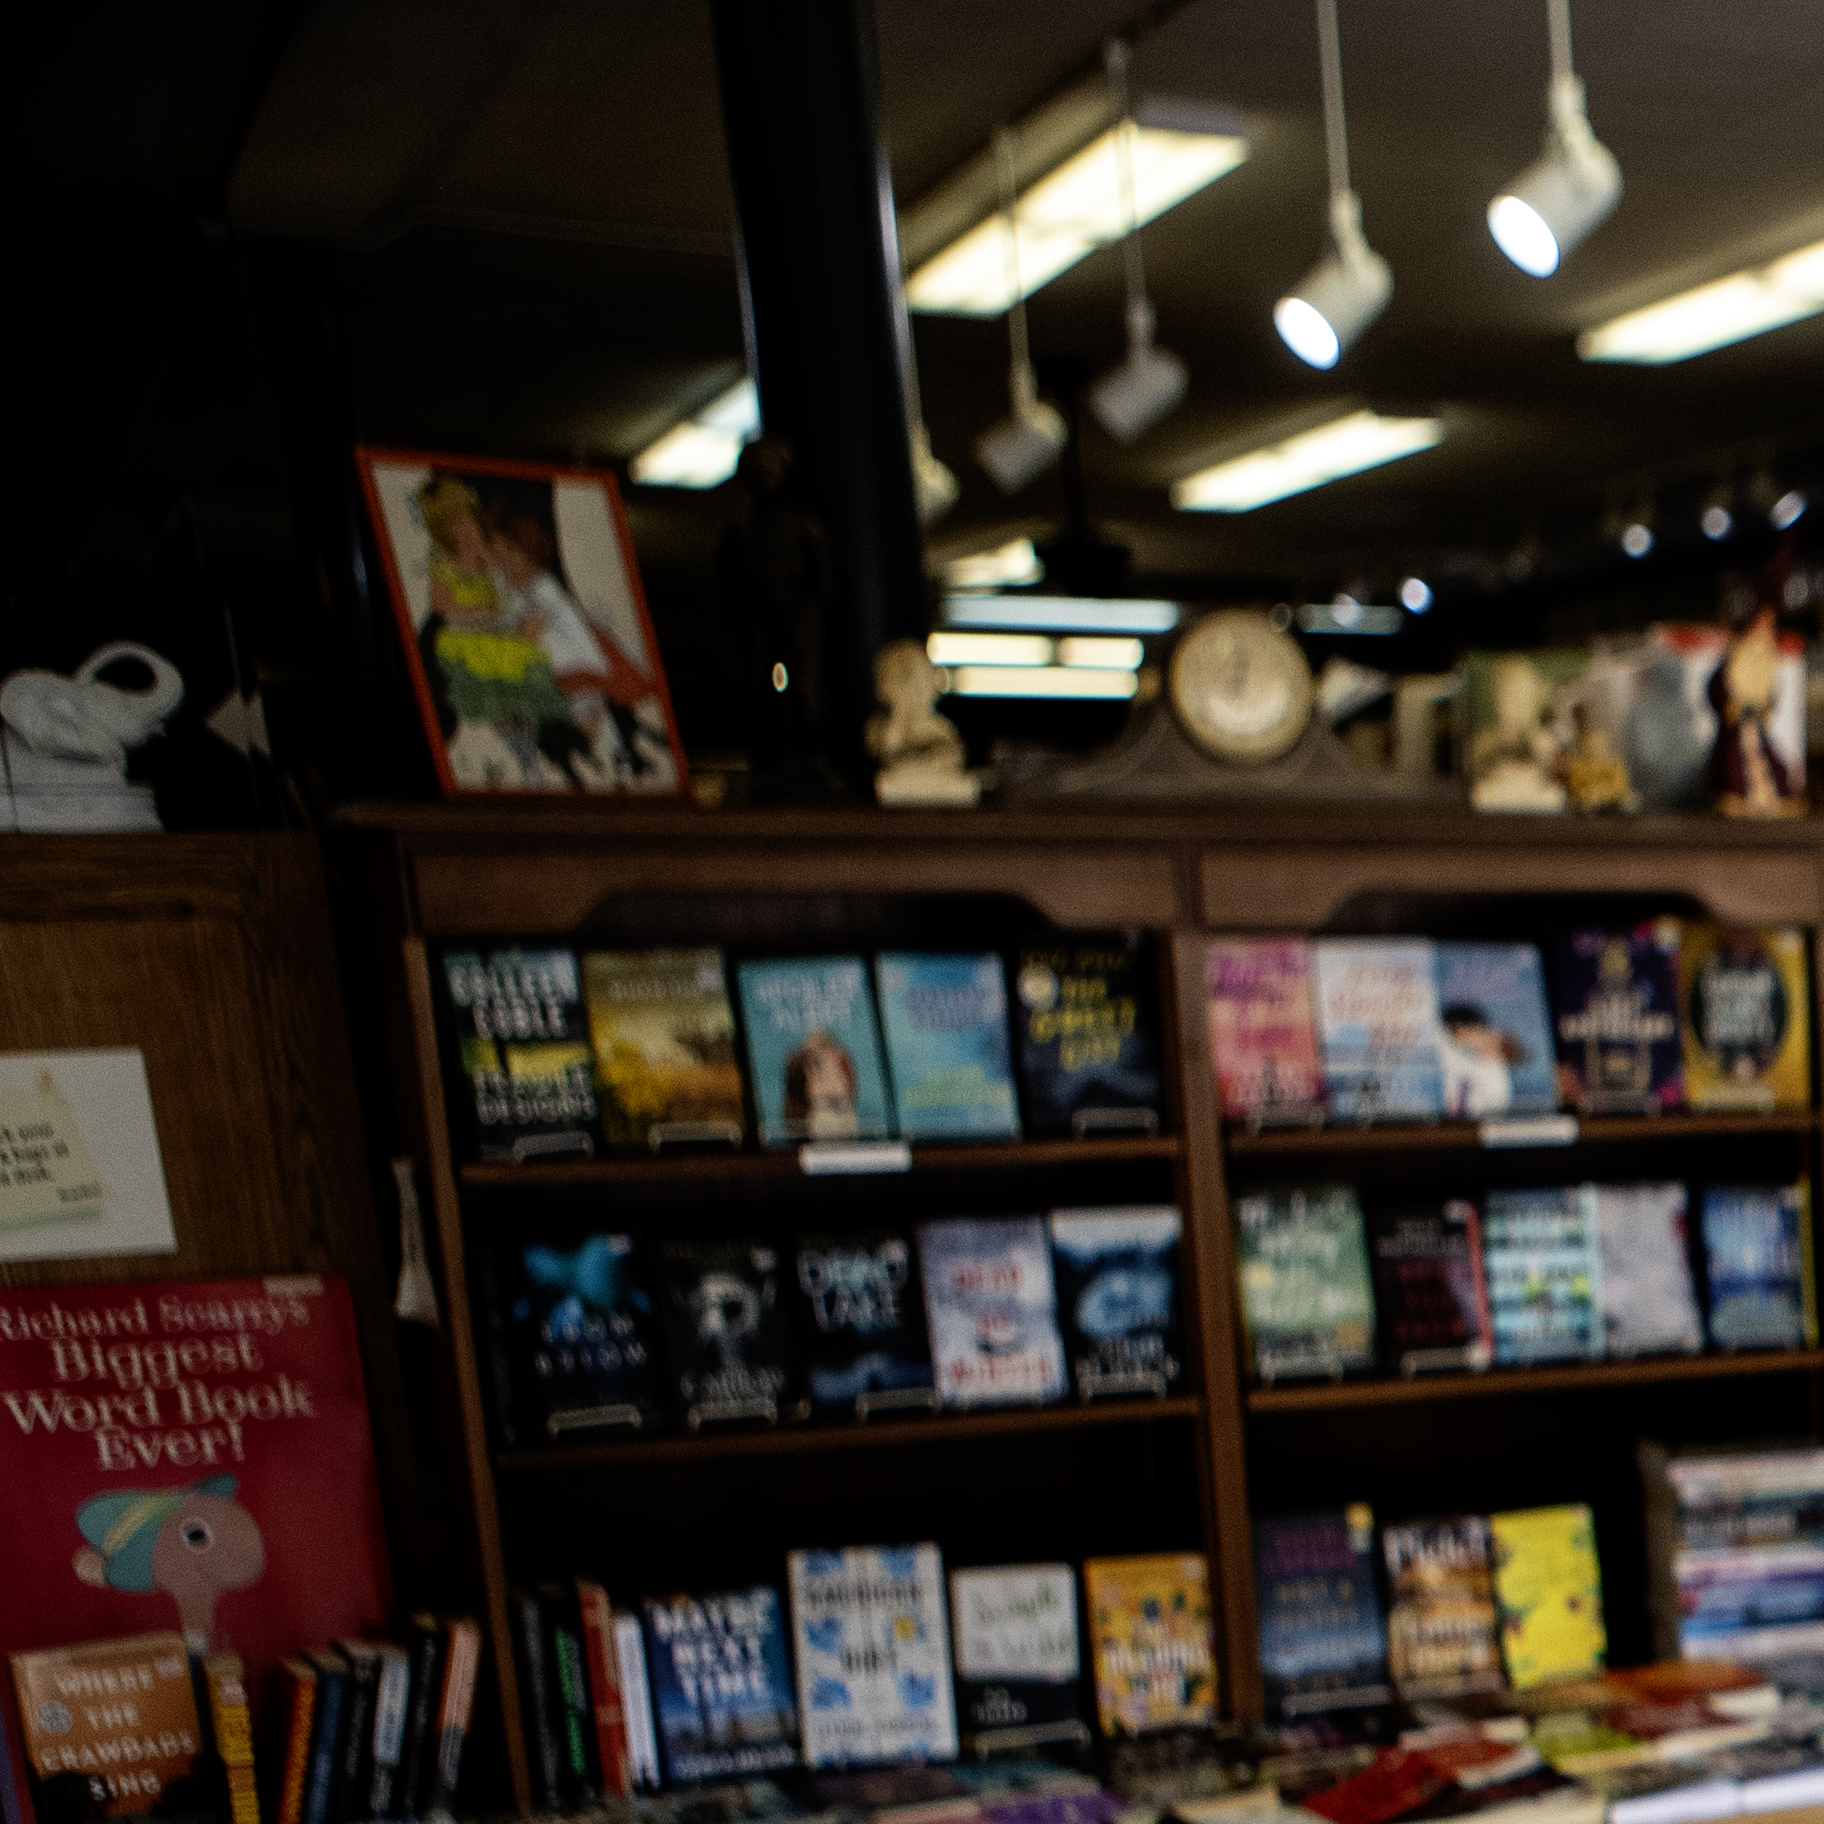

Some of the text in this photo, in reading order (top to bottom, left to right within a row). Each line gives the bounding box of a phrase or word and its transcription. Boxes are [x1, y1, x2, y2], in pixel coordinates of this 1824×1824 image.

[52, 1333, 265, 1391] Biggest
[1, 1373, 315, 1435] Word Book
[96, 1419, 245, 1471] Ever!
[56, 1665, 151, 1696] WHERE
[87, 1703, 139, 1730] THE
[42, 1730, 196, 1772] CRAWDADS
[89, 1768, 162, 1800] SING
